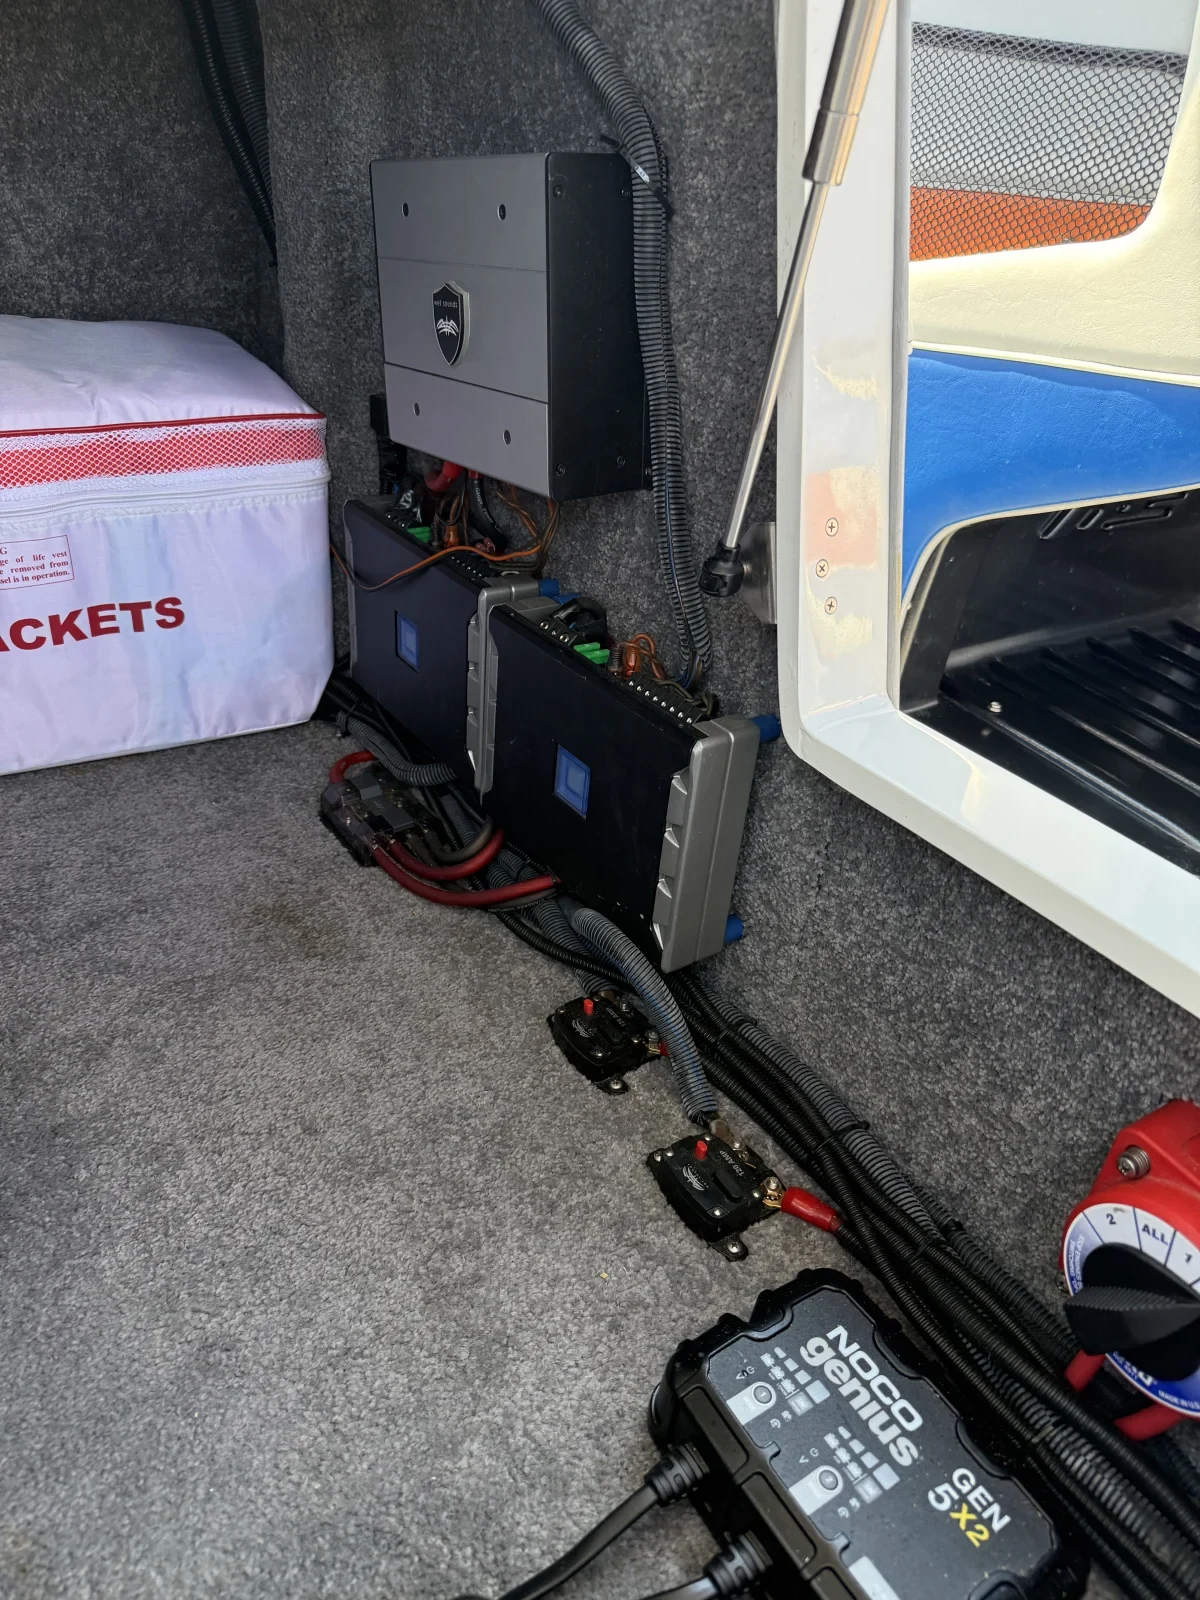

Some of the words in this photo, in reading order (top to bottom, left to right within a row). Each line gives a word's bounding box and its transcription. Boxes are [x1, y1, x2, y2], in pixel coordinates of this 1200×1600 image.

[11, 564, 45, 573] removed
[31, 570, 70, 581] operation.
[719, 1150, 735, 1167] AMP
[732, 1164, 745, 1177] 120
[1106, 1213, 1117, 1225] 2
[1141, 1224, 1169, 1246] ALL
[1185, 1253, 1193, 1263] 1
[826, 1325, 923, 1432] NOCO
[800, 1336, 919, 1467] genius
[952, 1467, 1011, 1534] GEN
[928, 1482, 990, 1548] 5X2
